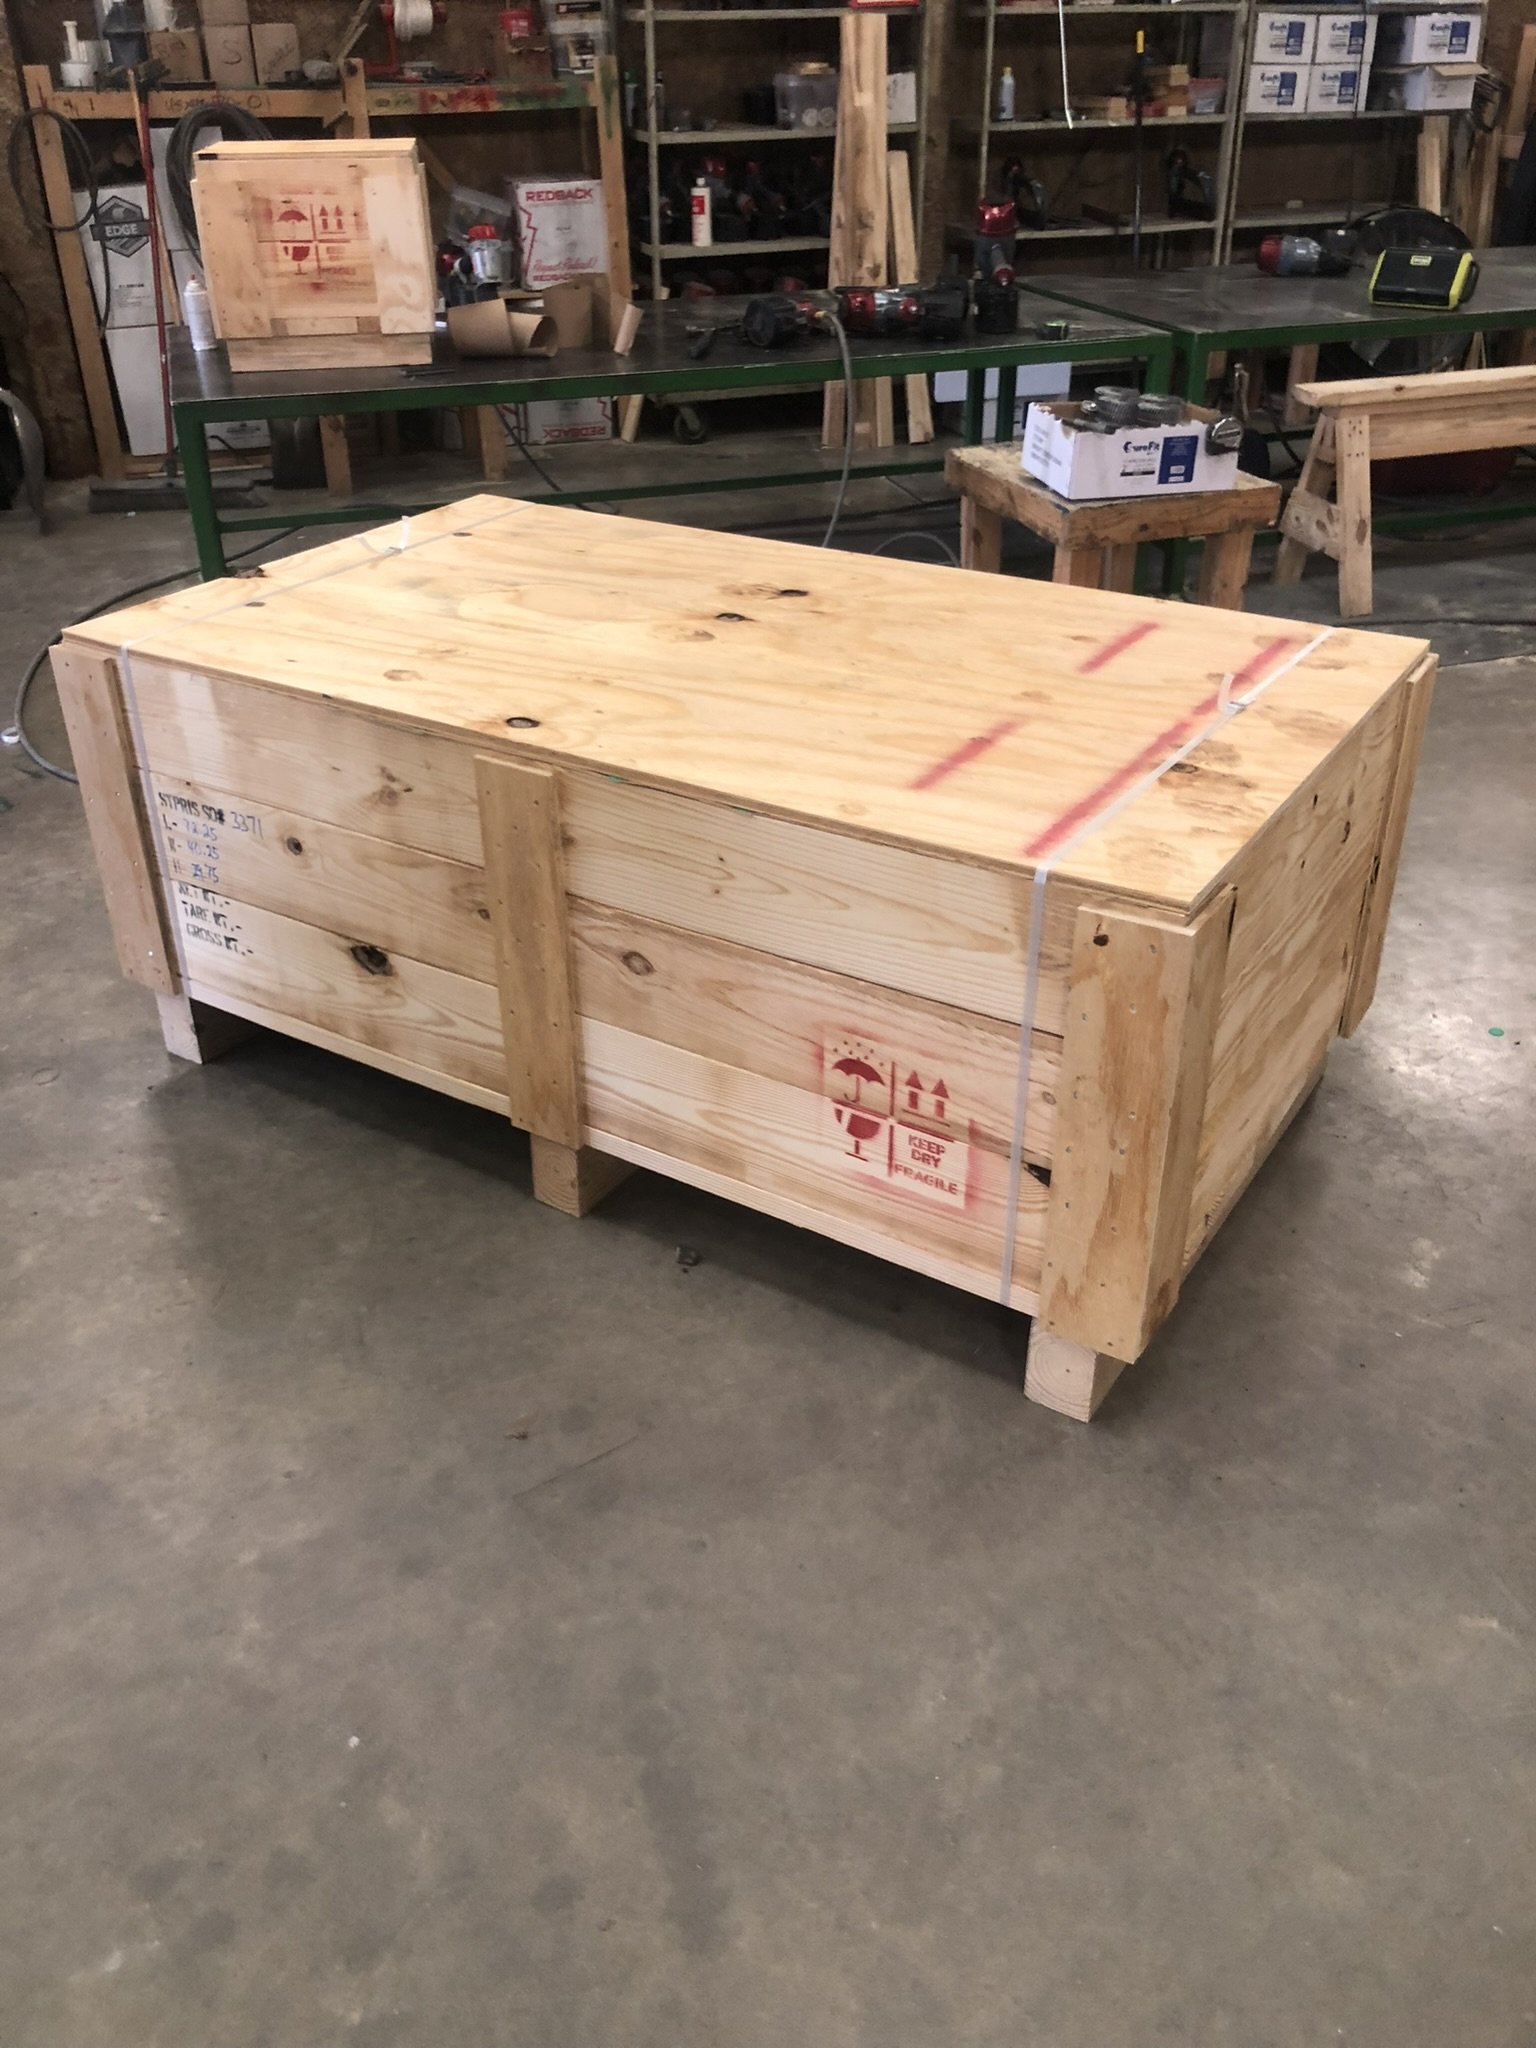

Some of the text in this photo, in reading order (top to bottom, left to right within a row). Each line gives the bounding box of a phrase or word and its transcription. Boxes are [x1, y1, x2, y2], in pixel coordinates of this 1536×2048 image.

[525, 188, 593, 201] REDBACK
[104, 224, 138, 237] EDGE
[908, 1134, 946, 1156] KEEP
[911, 1148, 941, 1168] DRY
[894, 1163, 959, 1195] FRAGILE
